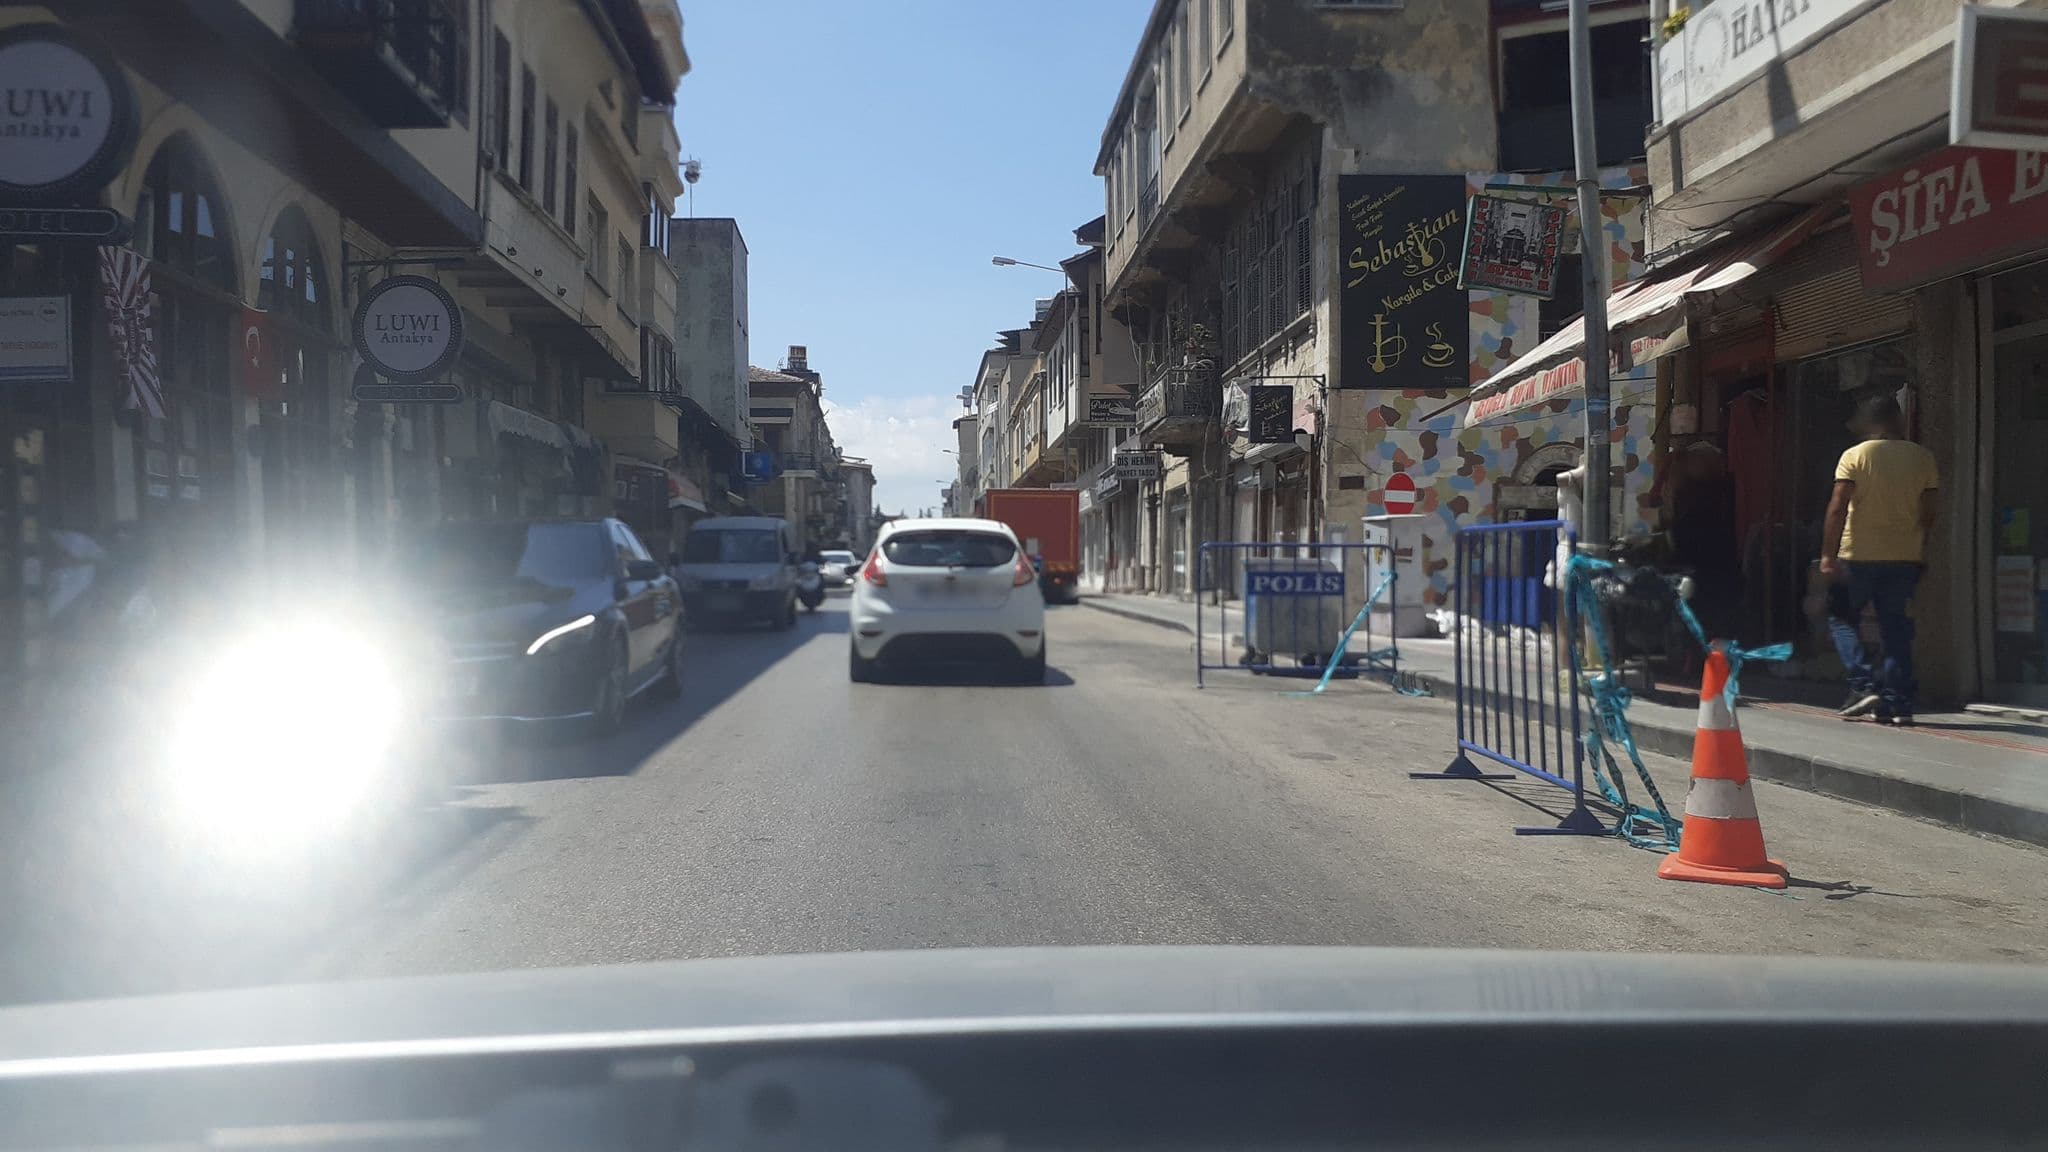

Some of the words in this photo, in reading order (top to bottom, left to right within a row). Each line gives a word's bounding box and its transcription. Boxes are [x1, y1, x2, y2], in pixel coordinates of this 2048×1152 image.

[1731, 0, 1811, 59] HATA
[0, 88, 92, 118] UWI
[0, 120, 80, 142] ntakya
[1869, 156, 1991, 267] ŞİFA
[1347, 208, 1460, 289] Sebastian
[1381, 285, 1423, 316] Nargile
[1423, 278, 1436, 292] &
[375, 314, 441, 331] LUWI
[381, 331, 433, 348] Antakya
[1254, 573, 1341, 592] POLİS
